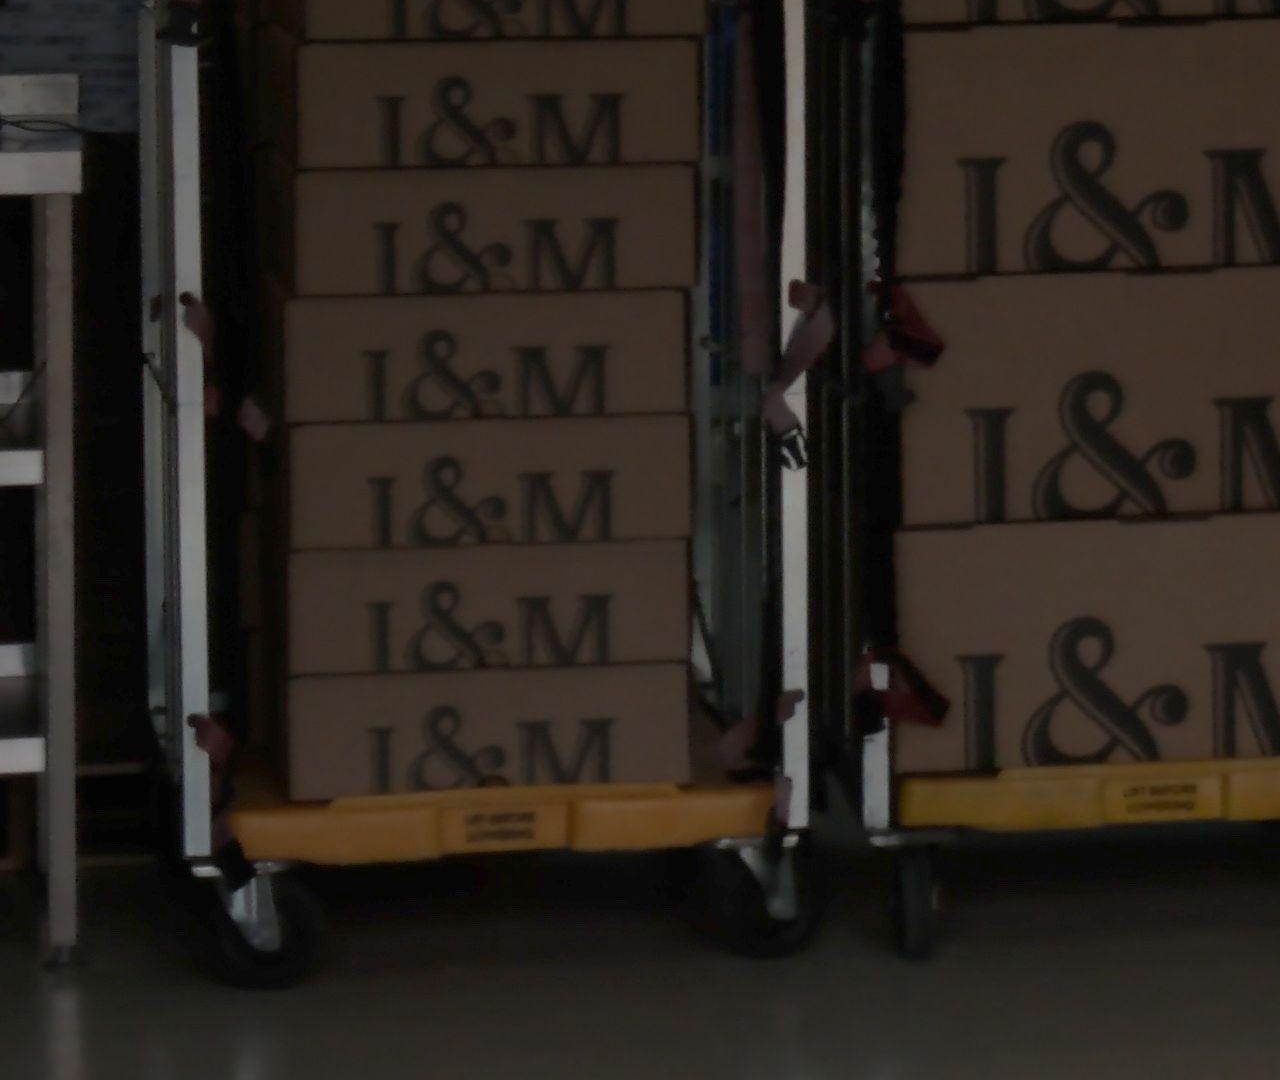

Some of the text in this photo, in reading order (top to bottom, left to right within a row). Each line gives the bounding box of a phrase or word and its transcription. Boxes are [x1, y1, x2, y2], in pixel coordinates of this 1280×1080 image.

[378, 75, 625, 167] I&M
[374, 202, 621, 293] I&M
[362, 329, 609, 420] I&M
[367, 455, 617, 546] I&M
[367, 580, 616, 671] I&M
[367, 705, 619, 794] I&M
